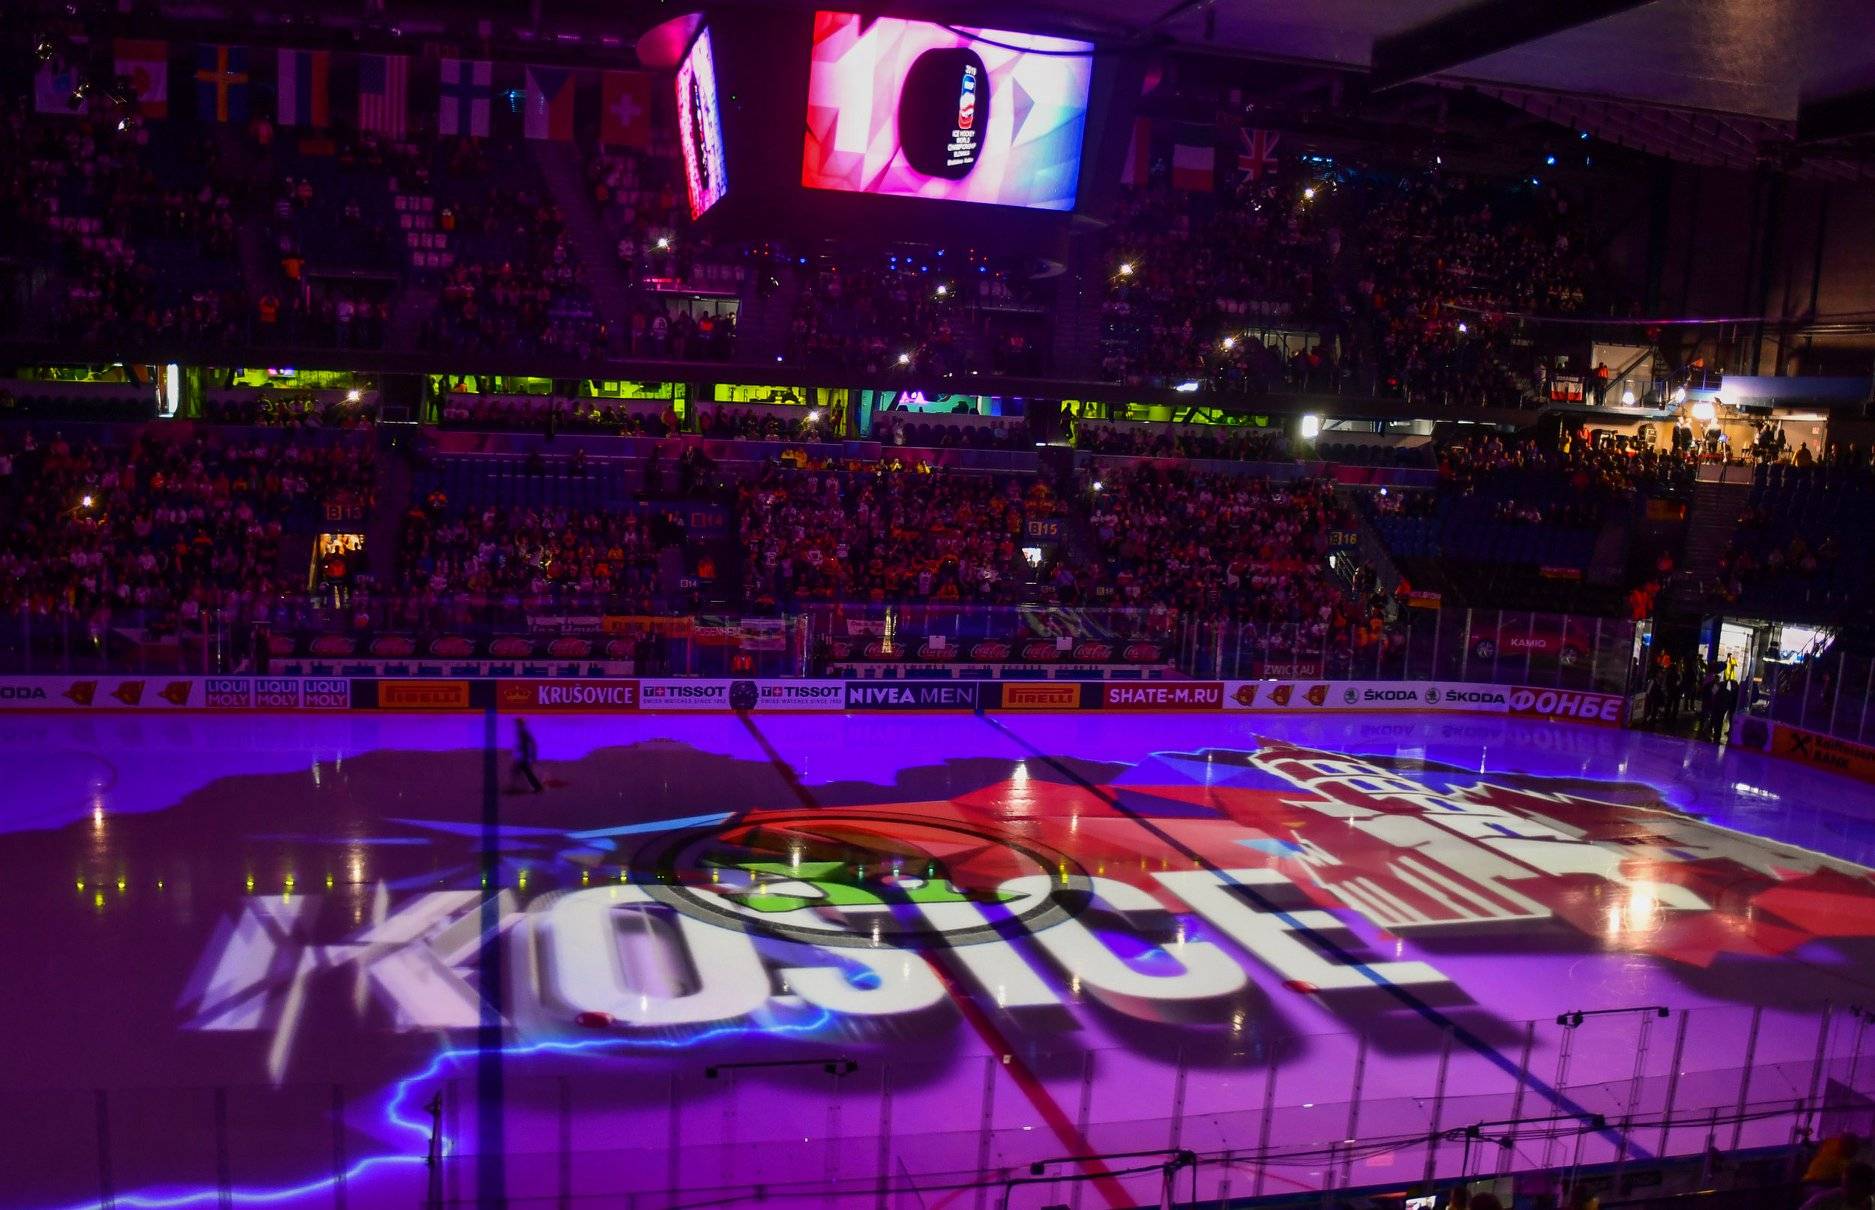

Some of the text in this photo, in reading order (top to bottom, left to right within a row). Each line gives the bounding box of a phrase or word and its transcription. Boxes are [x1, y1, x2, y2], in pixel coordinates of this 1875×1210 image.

[207, 680, 248, 693] LIQUI
[257, 680, 297, 693] LIQUI
[305, 681, 345, 693] LIQUI
[668, 686, 726, 698] TISSOT
[784, 686, 842, 698] TISSOT
[208, 694, 249, 705] MOLY
[257, 694, 297, 705] MOLY
[305, 694, 346, 706] MOLY
[538, 683, 633, 705] KRUŠOVICE
[850, 687, 916, 704] NIVEA
[921, 687, 973, 704] MEN
[1009, 687, 1073, 704] PIRELLI
[1109, 687, 1218, 704] SHATE-M.RU
[1364, 687, 1418, 701] ŠKODA
[1446, 689, 1506, 704] ŠKODA
